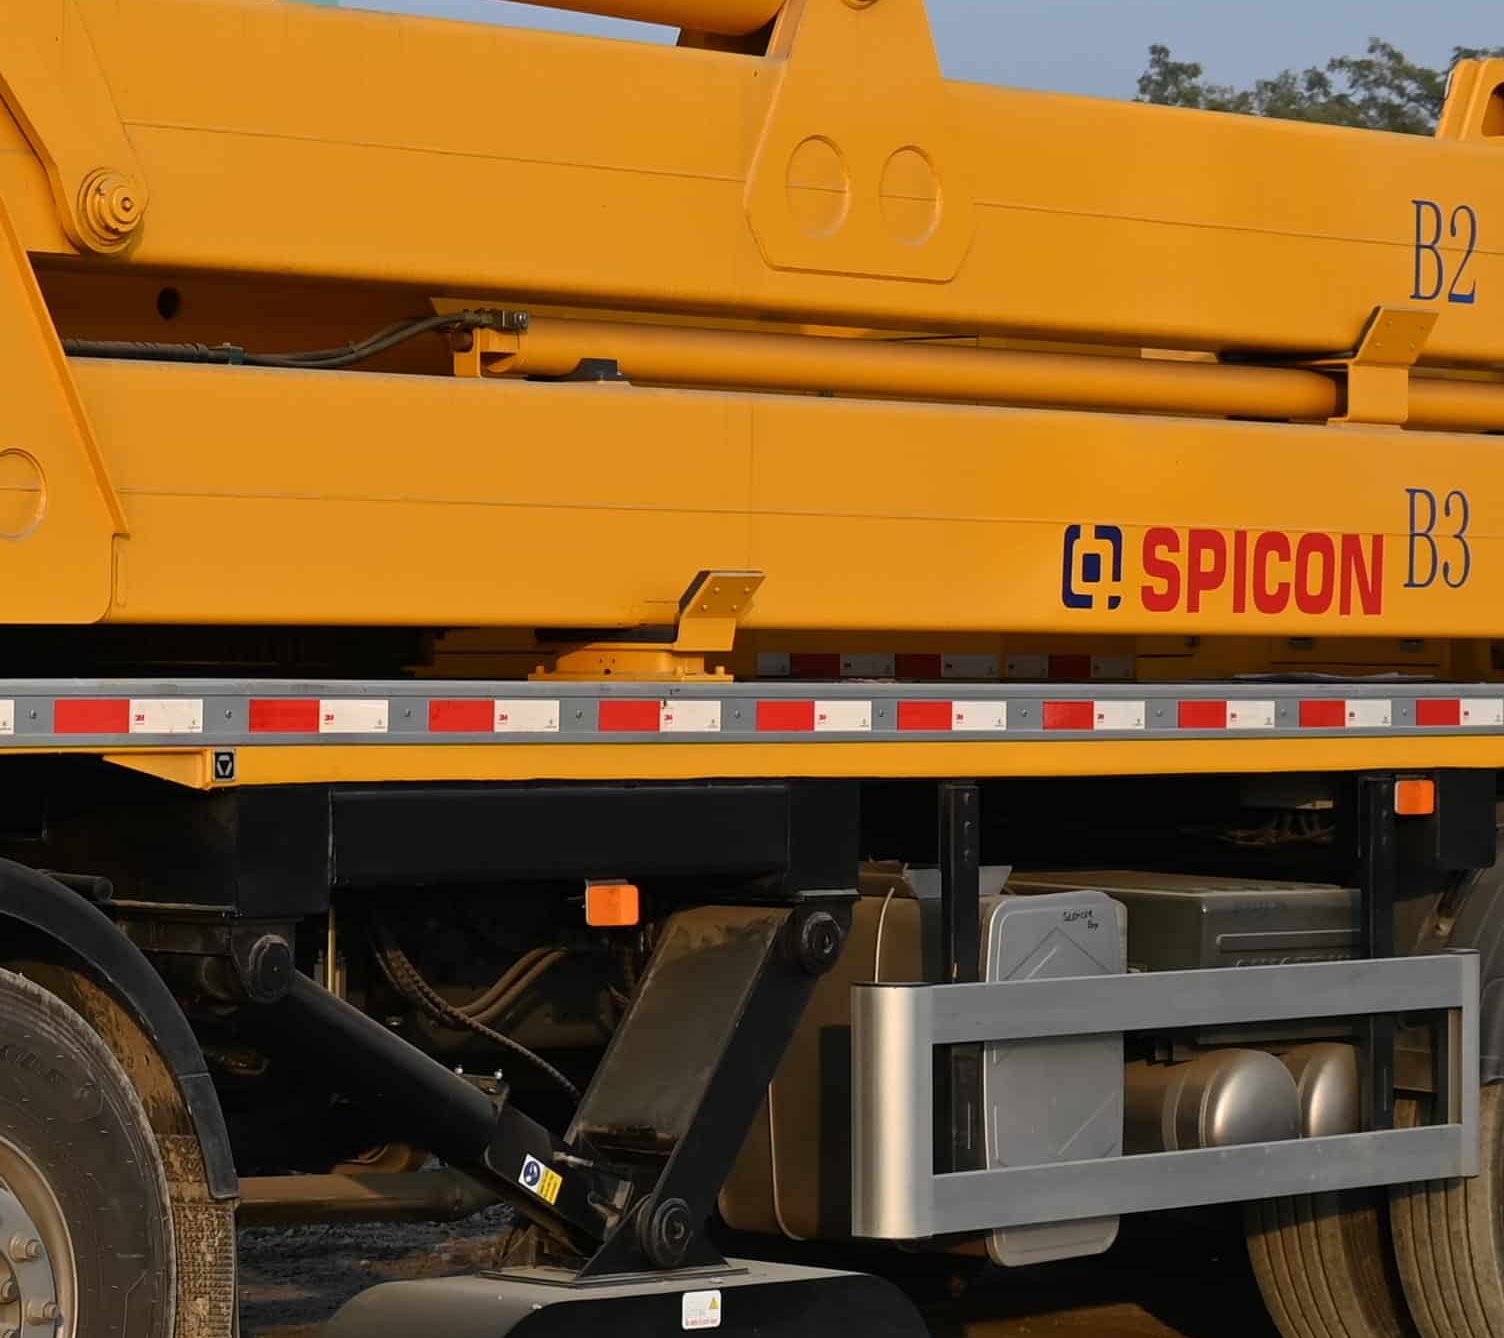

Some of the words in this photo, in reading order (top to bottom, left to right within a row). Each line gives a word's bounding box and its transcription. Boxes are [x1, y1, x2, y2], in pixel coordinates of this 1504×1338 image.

[1411, 198, 1478, 305] B2
[1142, 527, 1385, 616] SPICON
[1403, 488, 1472, 589] B3
